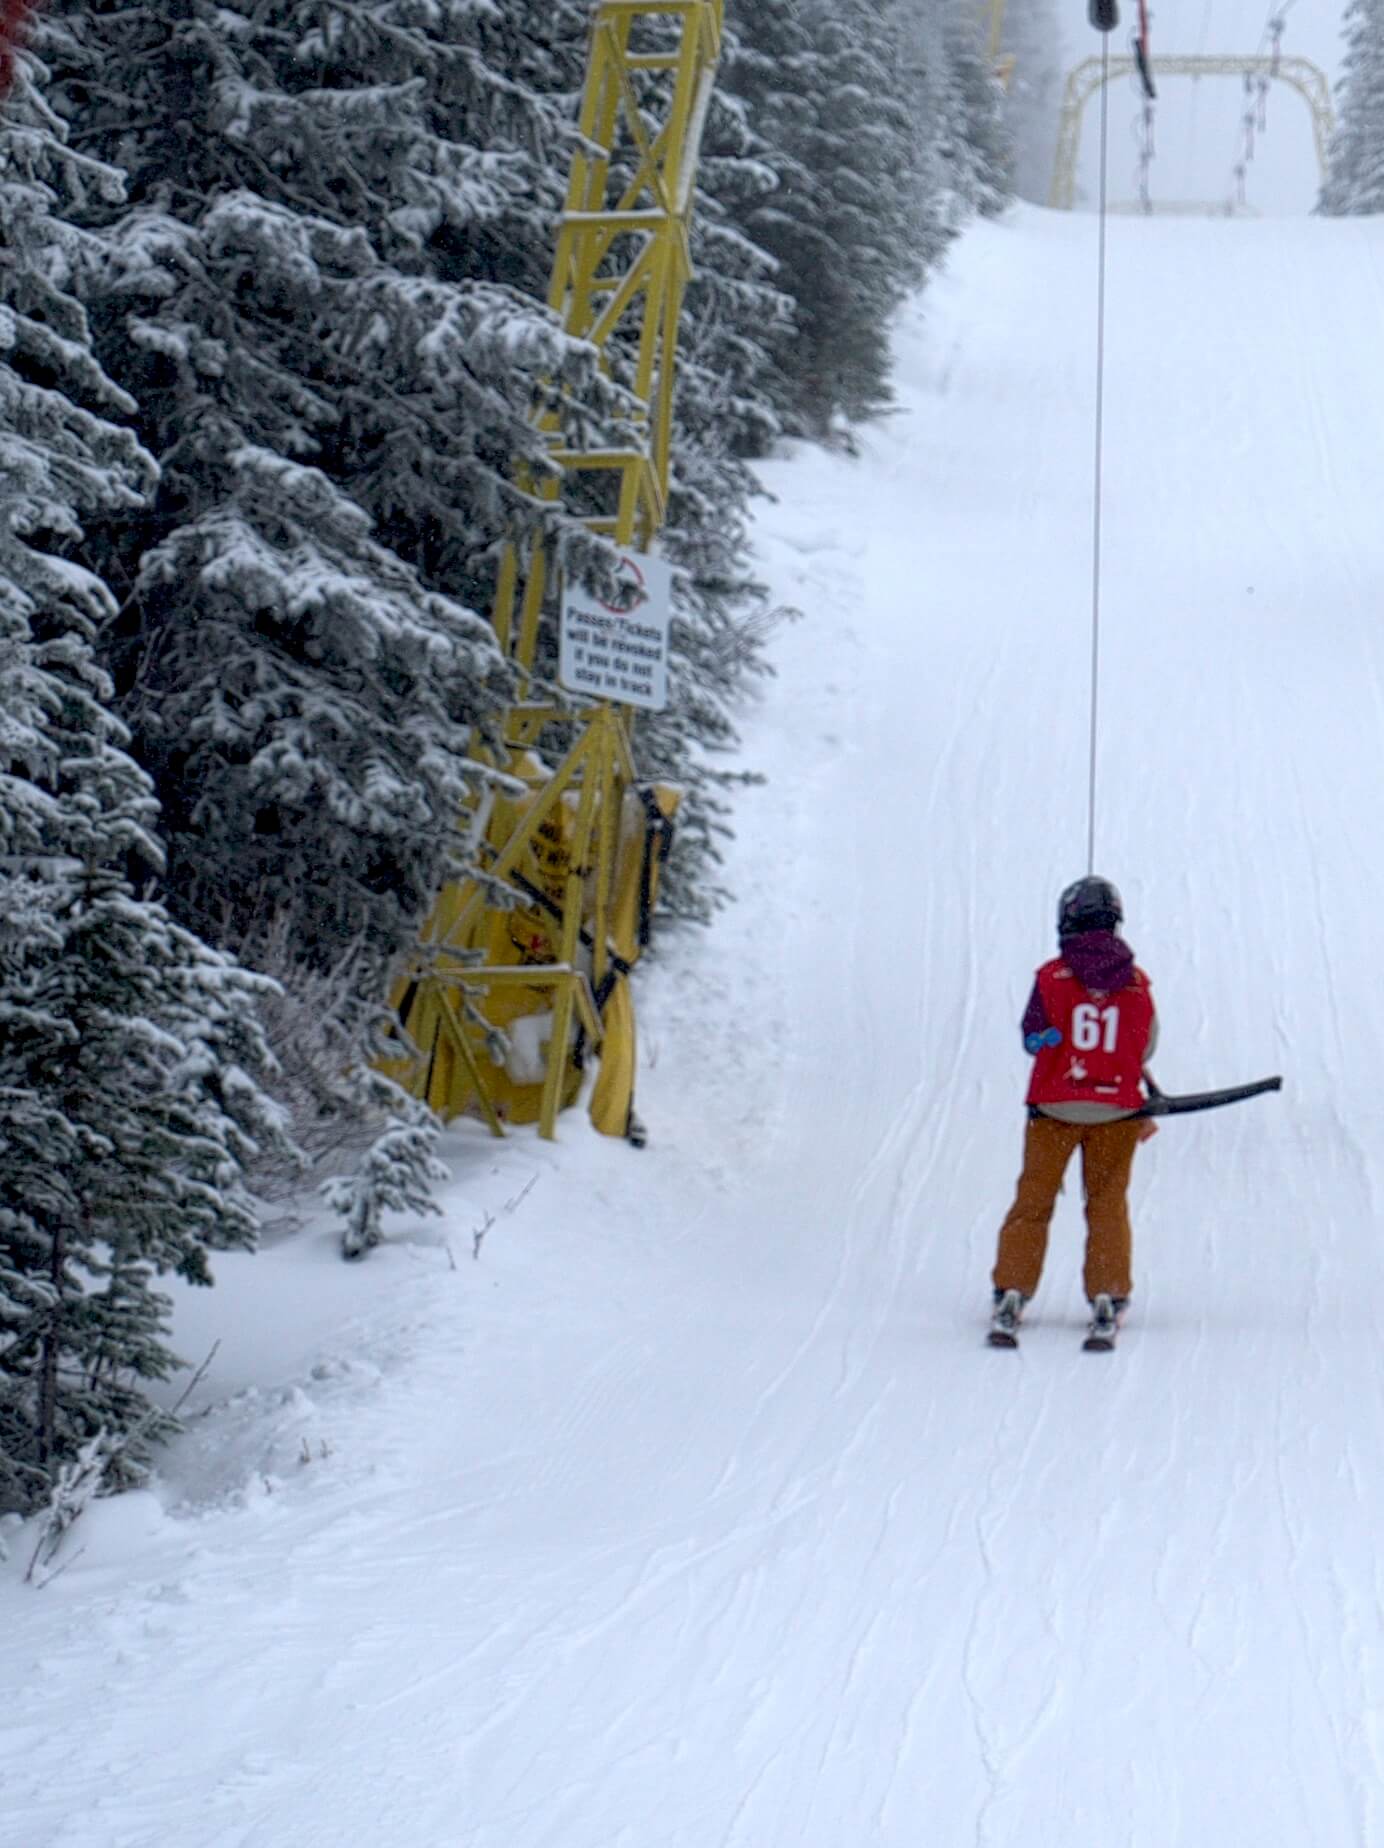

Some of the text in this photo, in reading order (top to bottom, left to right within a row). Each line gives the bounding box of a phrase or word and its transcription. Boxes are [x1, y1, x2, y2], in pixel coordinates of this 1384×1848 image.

[567, 630, 661, 660] will be revoked
[575, 647, 652, 677] if you do not
[575, 667, 651, 695] stay in track
[1072, 1003, 1119, 1053] 61
